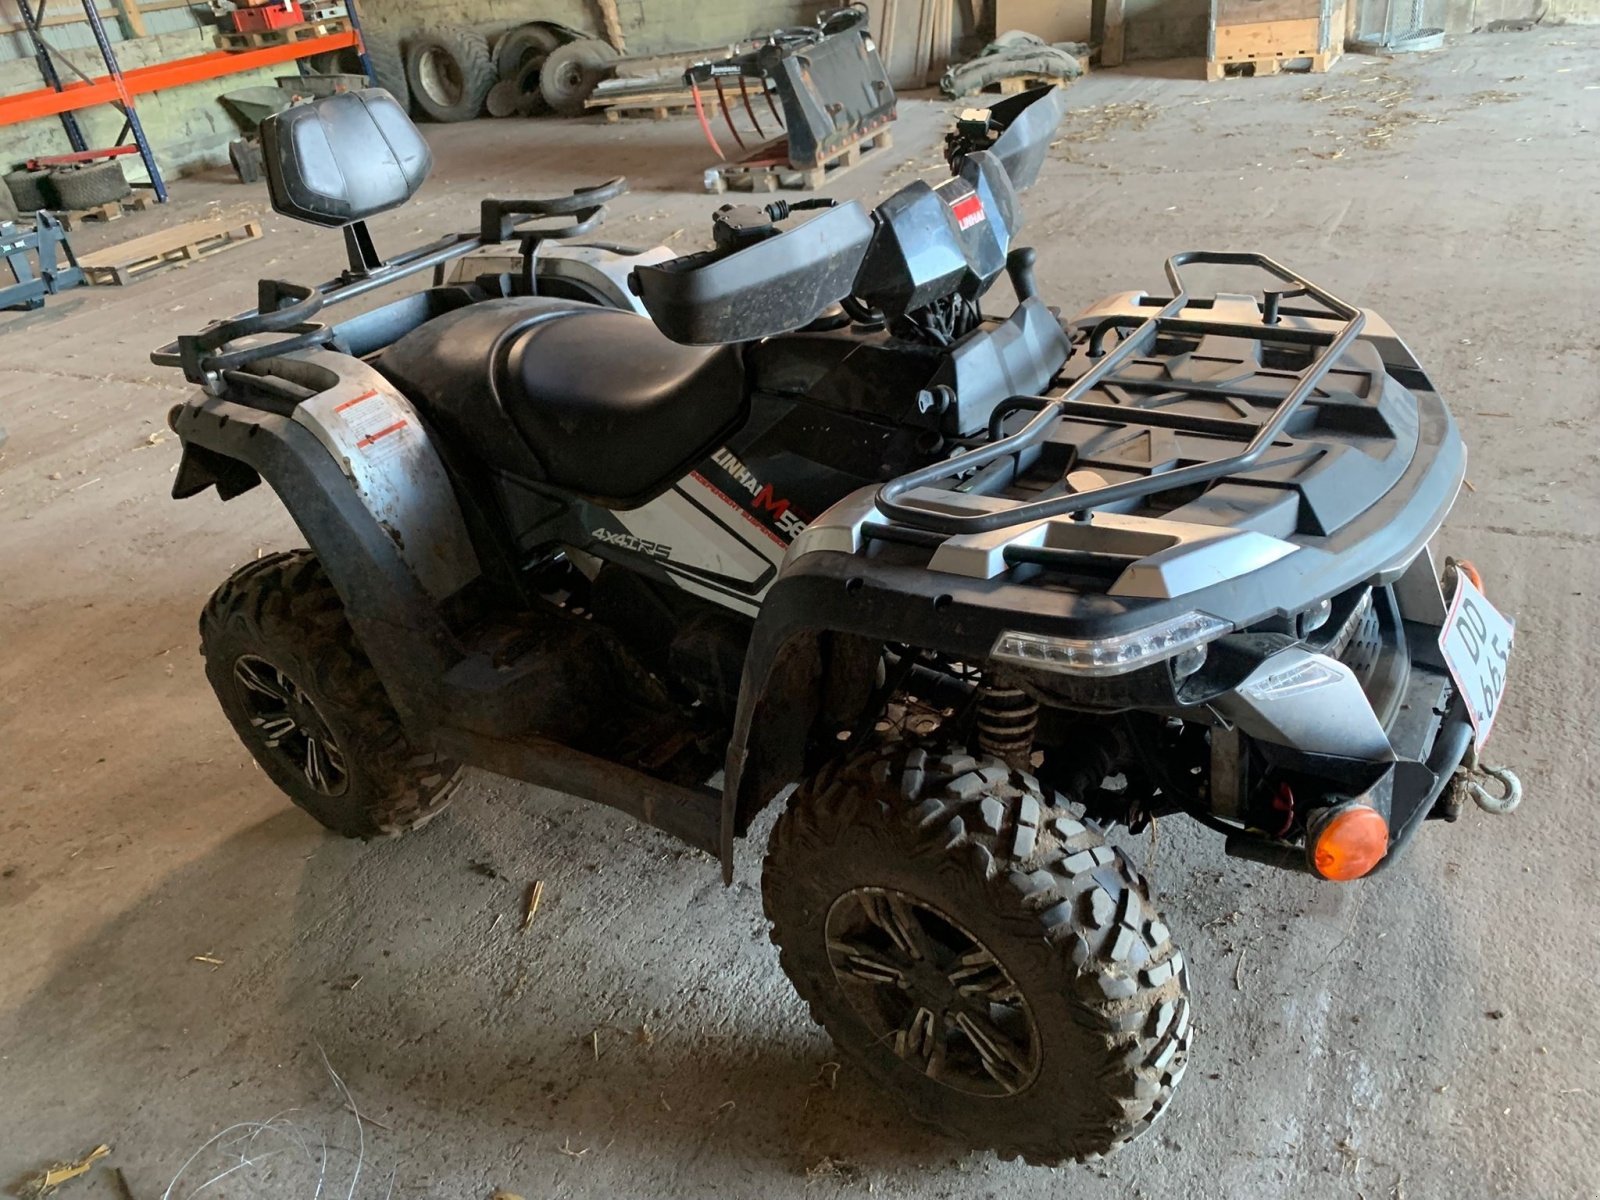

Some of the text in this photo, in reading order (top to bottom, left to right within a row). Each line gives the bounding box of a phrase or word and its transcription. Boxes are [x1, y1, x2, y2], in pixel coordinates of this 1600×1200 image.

[958, 208, 986, 231] LINHAI
[690, 469, 741, 511] INDEPENDENT
[711, 447, 763, 497] LINHAI
[1456, 597, 1487, 665] DD
